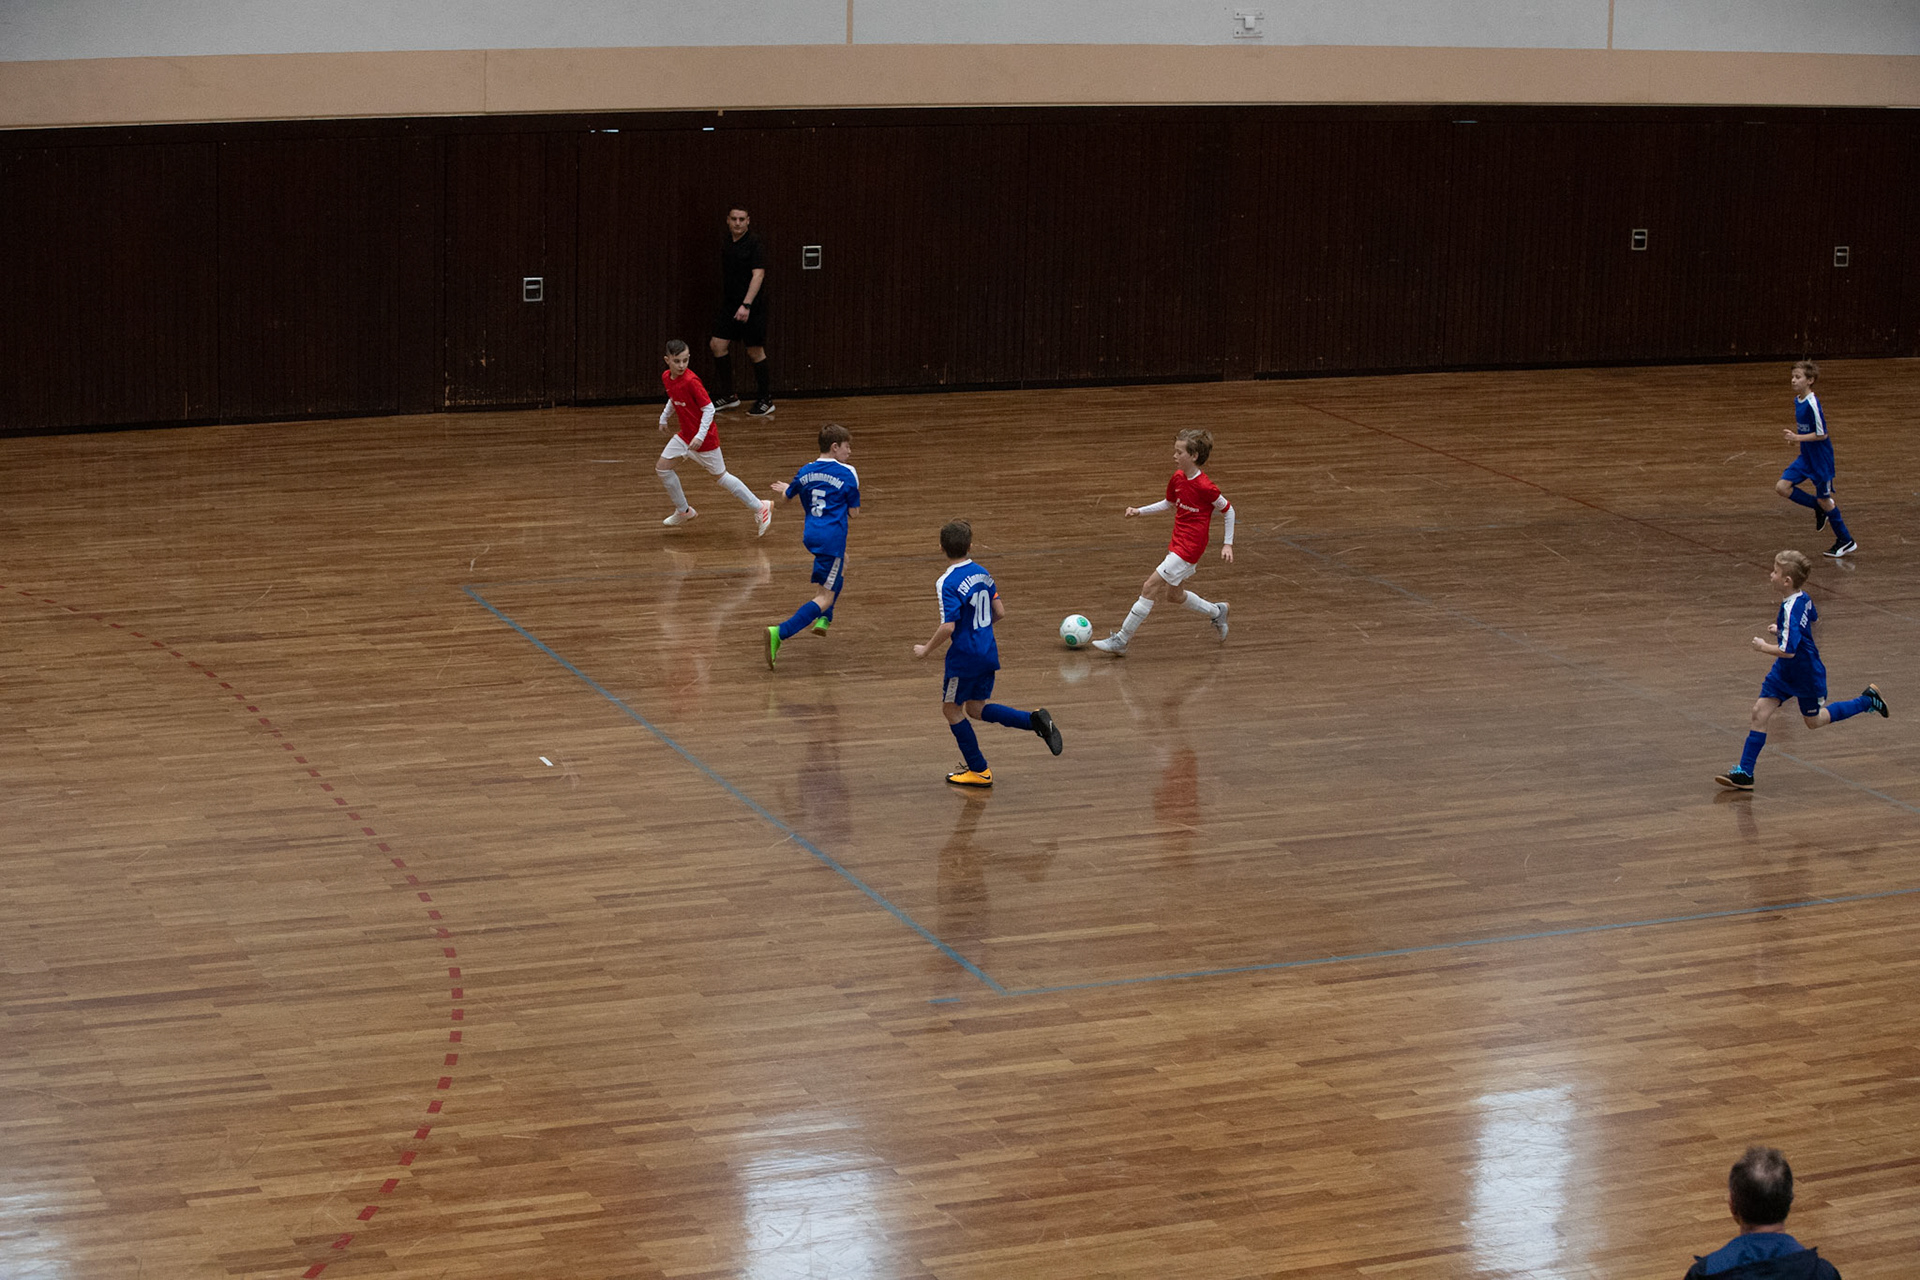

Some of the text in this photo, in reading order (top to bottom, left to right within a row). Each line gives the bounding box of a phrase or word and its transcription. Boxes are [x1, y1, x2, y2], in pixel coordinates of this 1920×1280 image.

[811, 489, 827, 517] 5
[957, 580, 970, 596] TSV
[969, 590, 992, 630] 10
